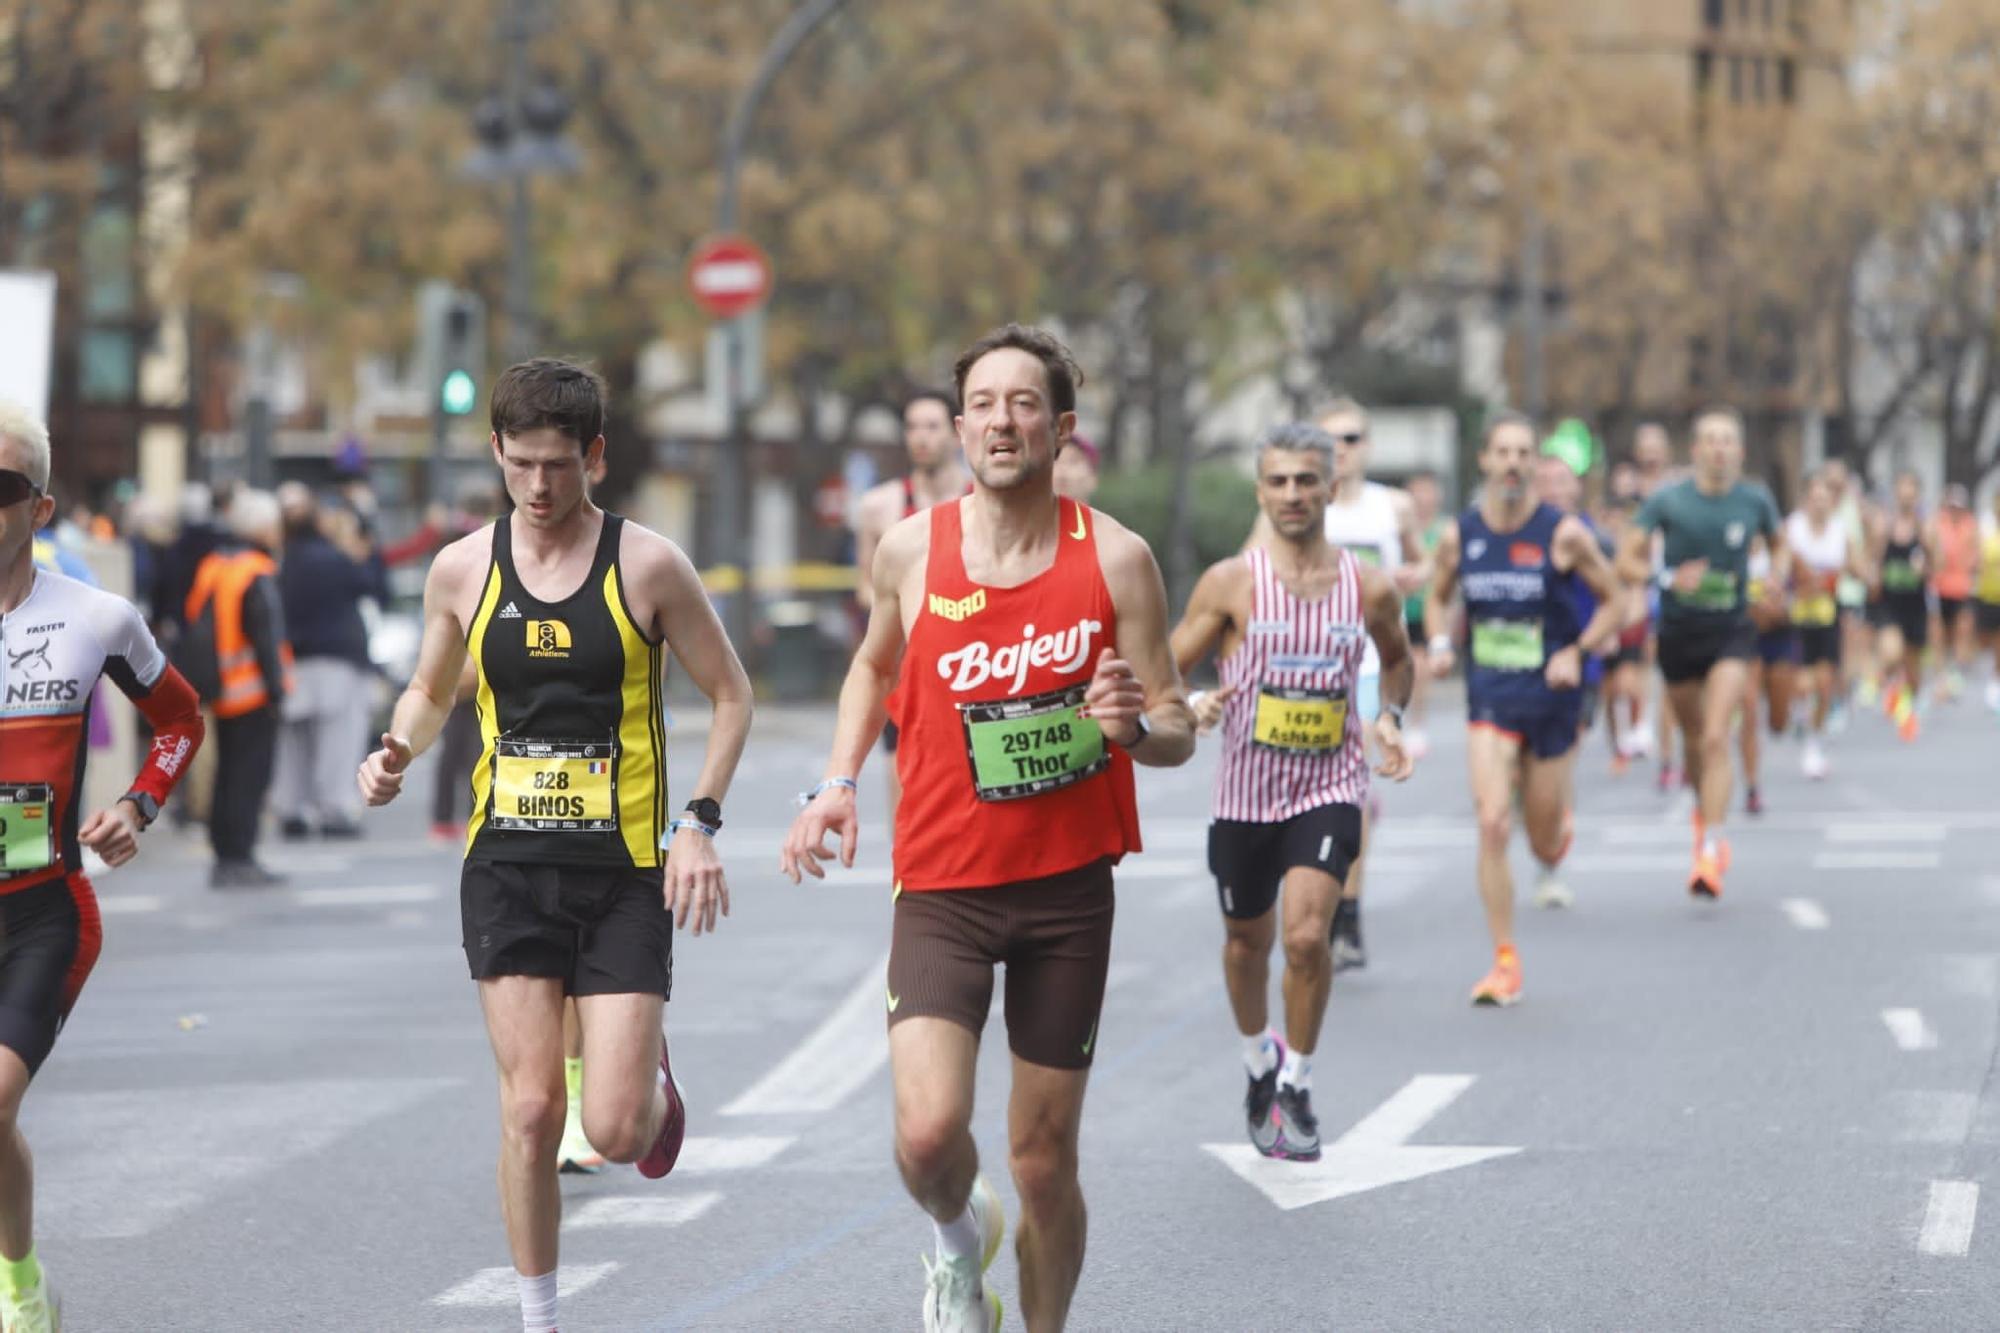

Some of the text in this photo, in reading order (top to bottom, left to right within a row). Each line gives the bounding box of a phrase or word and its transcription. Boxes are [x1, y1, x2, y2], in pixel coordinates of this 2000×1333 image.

[929, 588, 986, 622] NBRO
[26, 622, 65, 634] FASTER
[937, 618, 1102, 695] Bajeur
[1001, 722, 1072, 754] 29748
[1012, 752, 1069, 779] Thor
[534, 771, 569, 790] 828
[518, 795, 585, 817] BINOS
